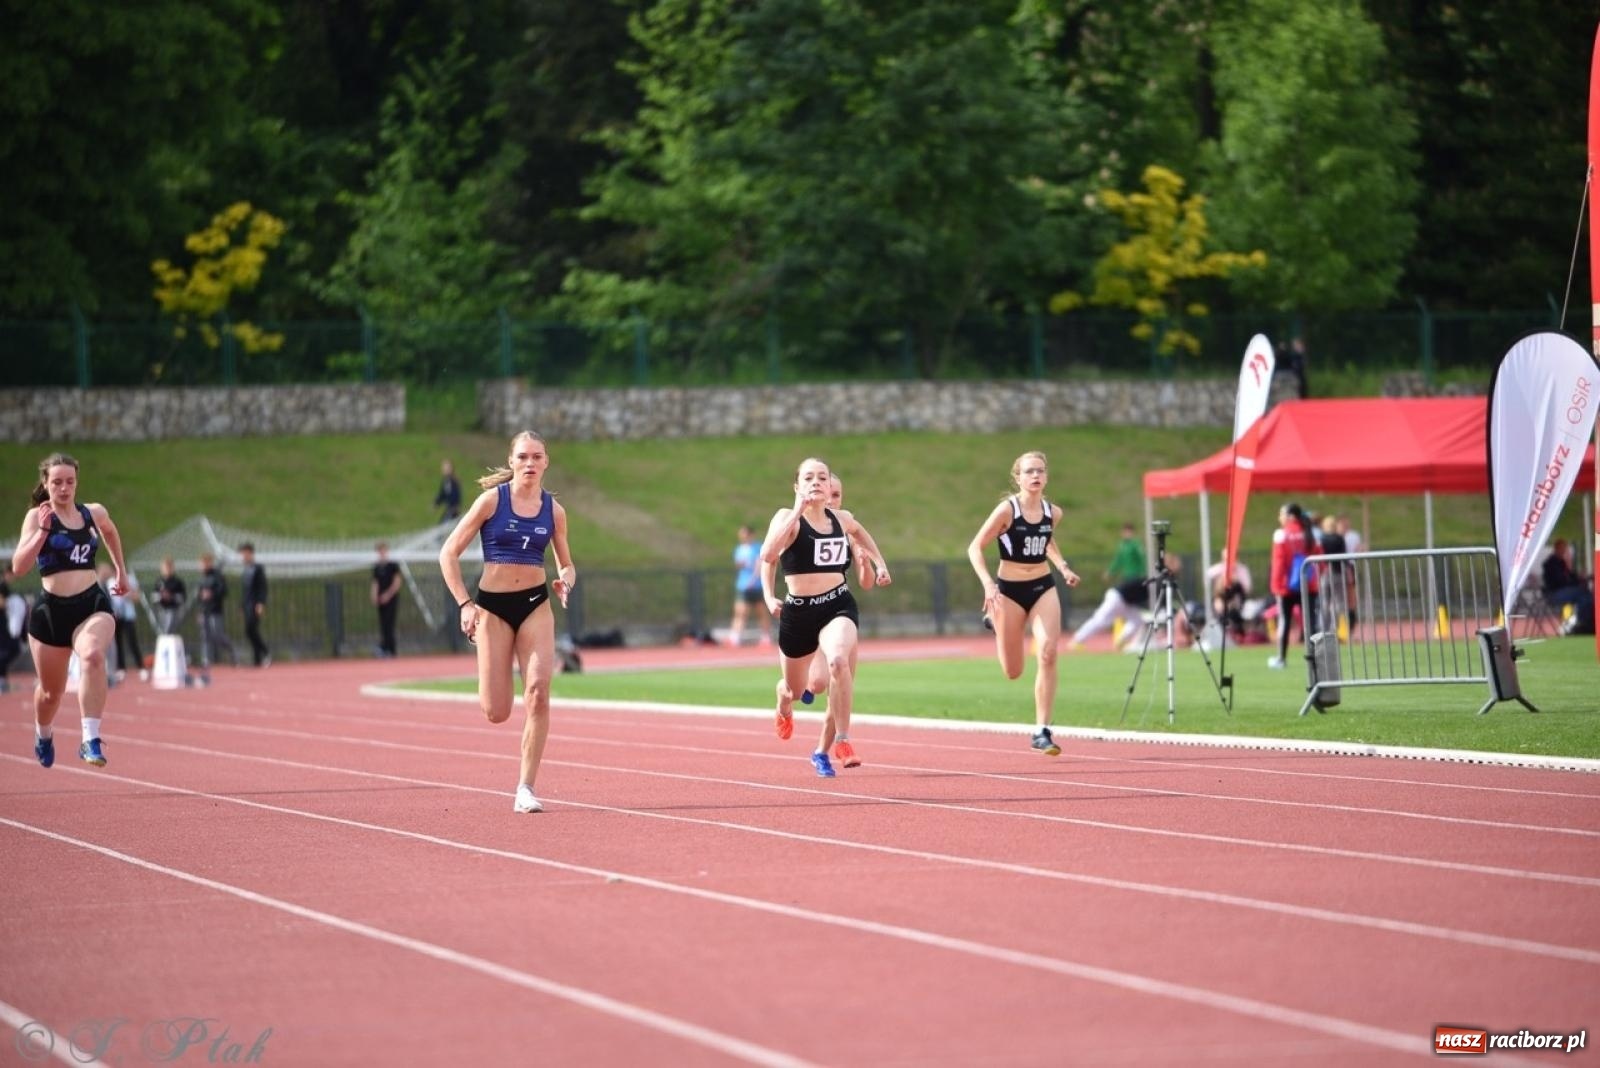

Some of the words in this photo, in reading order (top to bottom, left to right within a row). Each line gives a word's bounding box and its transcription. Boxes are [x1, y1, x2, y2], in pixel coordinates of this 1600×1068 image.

[1566, 376, 1592, 425] OSiR
[521, 535, 531, 550] 7
[819, 541, 844, 563] 57
[1023, 535, 1047, 556] 300
[69, 543, 91, 564] 42
[809, 590, 837, 605] NIKE
